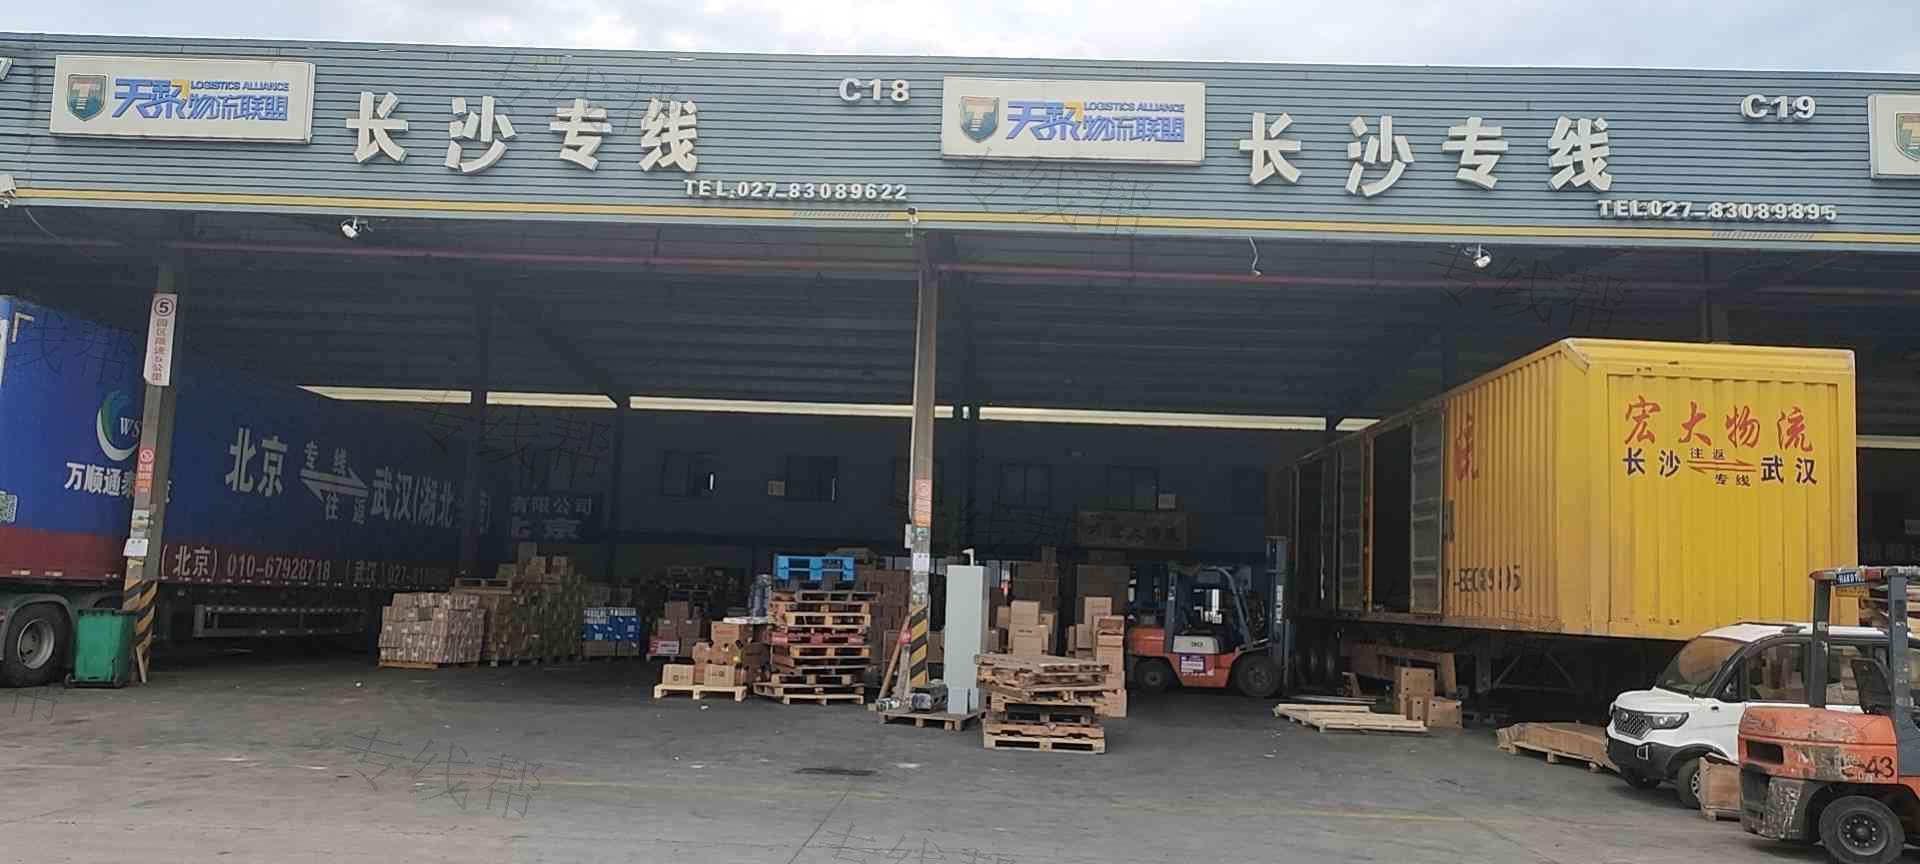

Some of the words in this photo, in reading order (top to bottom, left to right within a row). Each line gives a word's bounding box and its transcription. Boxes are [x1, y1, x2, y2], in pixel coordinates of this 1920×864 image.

[190, 79, 241, 90] LOGISTICS
[242, 81, 289, 92] ALLIANCE
[838, 78, 911, 103] C18
[1084, 101, 1136, 112] LOGISTICS
[1136, 102, 1185, 113] ALLIANCE
[1740, 94, 1816, 119] C19
[346, 90, 700, 174] 长沙专线
[1239, 111, 1614, 198] 长沙专线
[1624, 396, 1813, 452] 宏大物流
[225, 428, 288, 496] 北京
[1623, 447, 1681, 477] 长沙
[1690, 447, 1725, 459] 往返
[1714, 474, 1751, 487] 专线
[1761, 454, 1817, 484] 武汉
